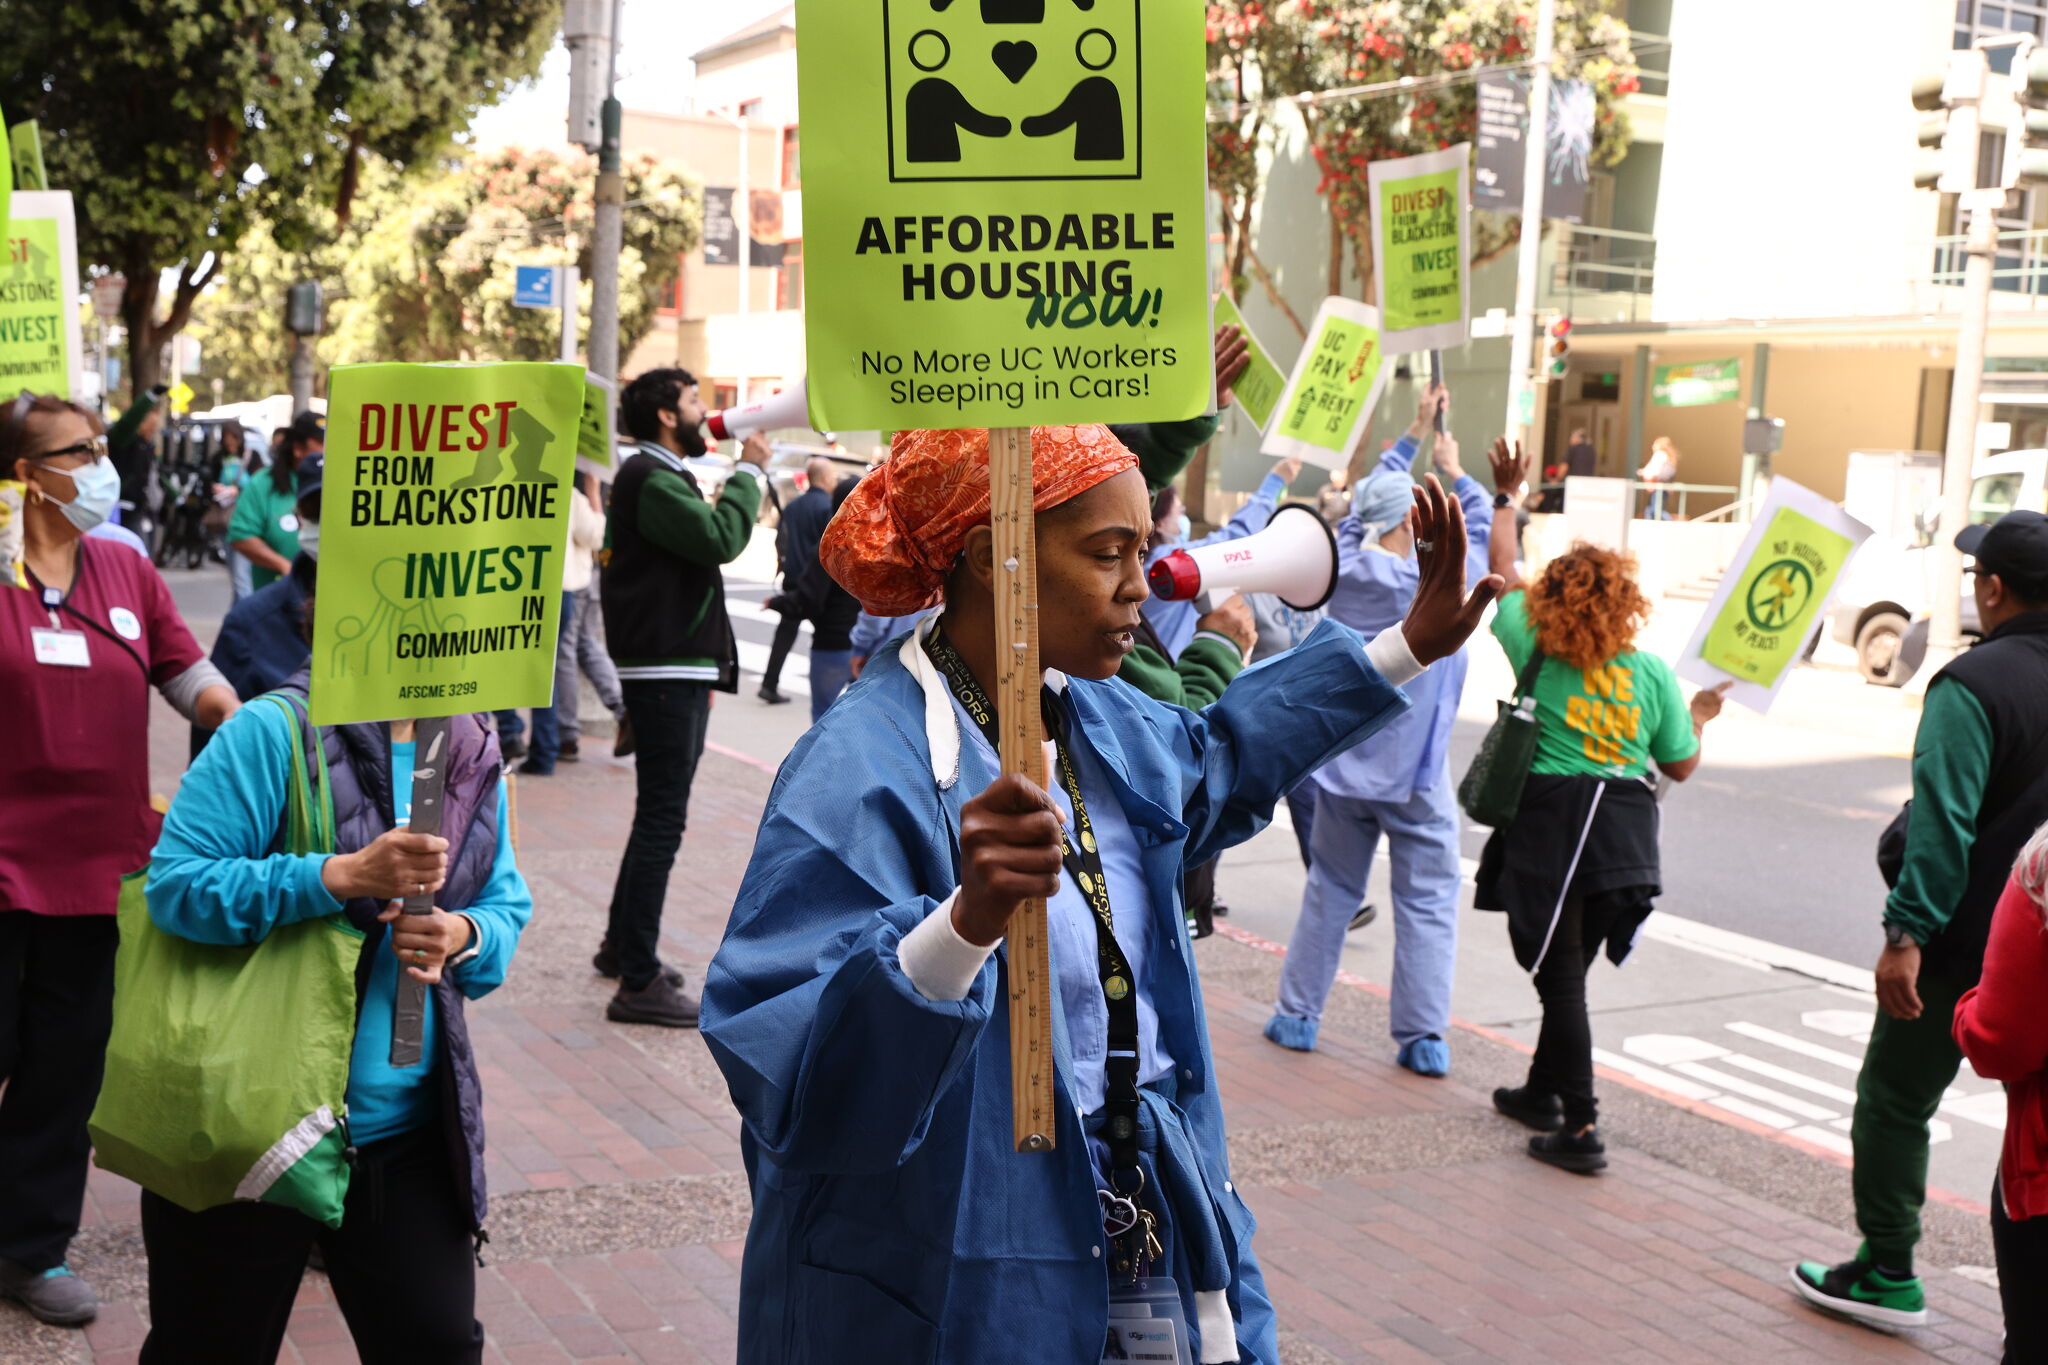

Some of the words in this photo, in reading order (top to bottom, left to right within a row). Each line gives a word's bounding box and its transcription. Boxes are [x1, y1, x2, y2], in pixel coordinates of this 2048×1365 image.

[1392, 187, 1444, 213] DIVEST
[855, 212, 1175, 255] AFFORDABLE
[902, 260, 1133, 301] HOUSING
[1025, 287, 1163, 330] NOW!
[1323, 330, 1346, 352] UC
[861, 351, 902, 375] No
[913, 349, 991, 374] More
[1001, 347, 1043, 371] UC
[1053, 344, 1177, 370] Workers
[1312, 354, 1345, 379] PAY
[890, 378, 1024, 410] Sleeping
[1035, 375, 1059, 400] in
[1069, 373, 1150, 399] Cars!
[1317, 391, 1354, 416] RENT
[359, 401, 517, 451] DIVEST
[1325, 415, 1341, 433] IS
[355, 456, 434, 486] FROM
[351, 483, 558, 527] BLACKSTONE
[404, 545, 552, 599] INVEST
[521, 596, 544, 621] IN
[396, 624, 541, 659] COMMUNITY!
[399, 686, 445, 699] AFSCME
[449, 681, 477, 697] 3299
[1583, 664, 1633, 702] WE
[1565, 696, 1641, 740] RUN
